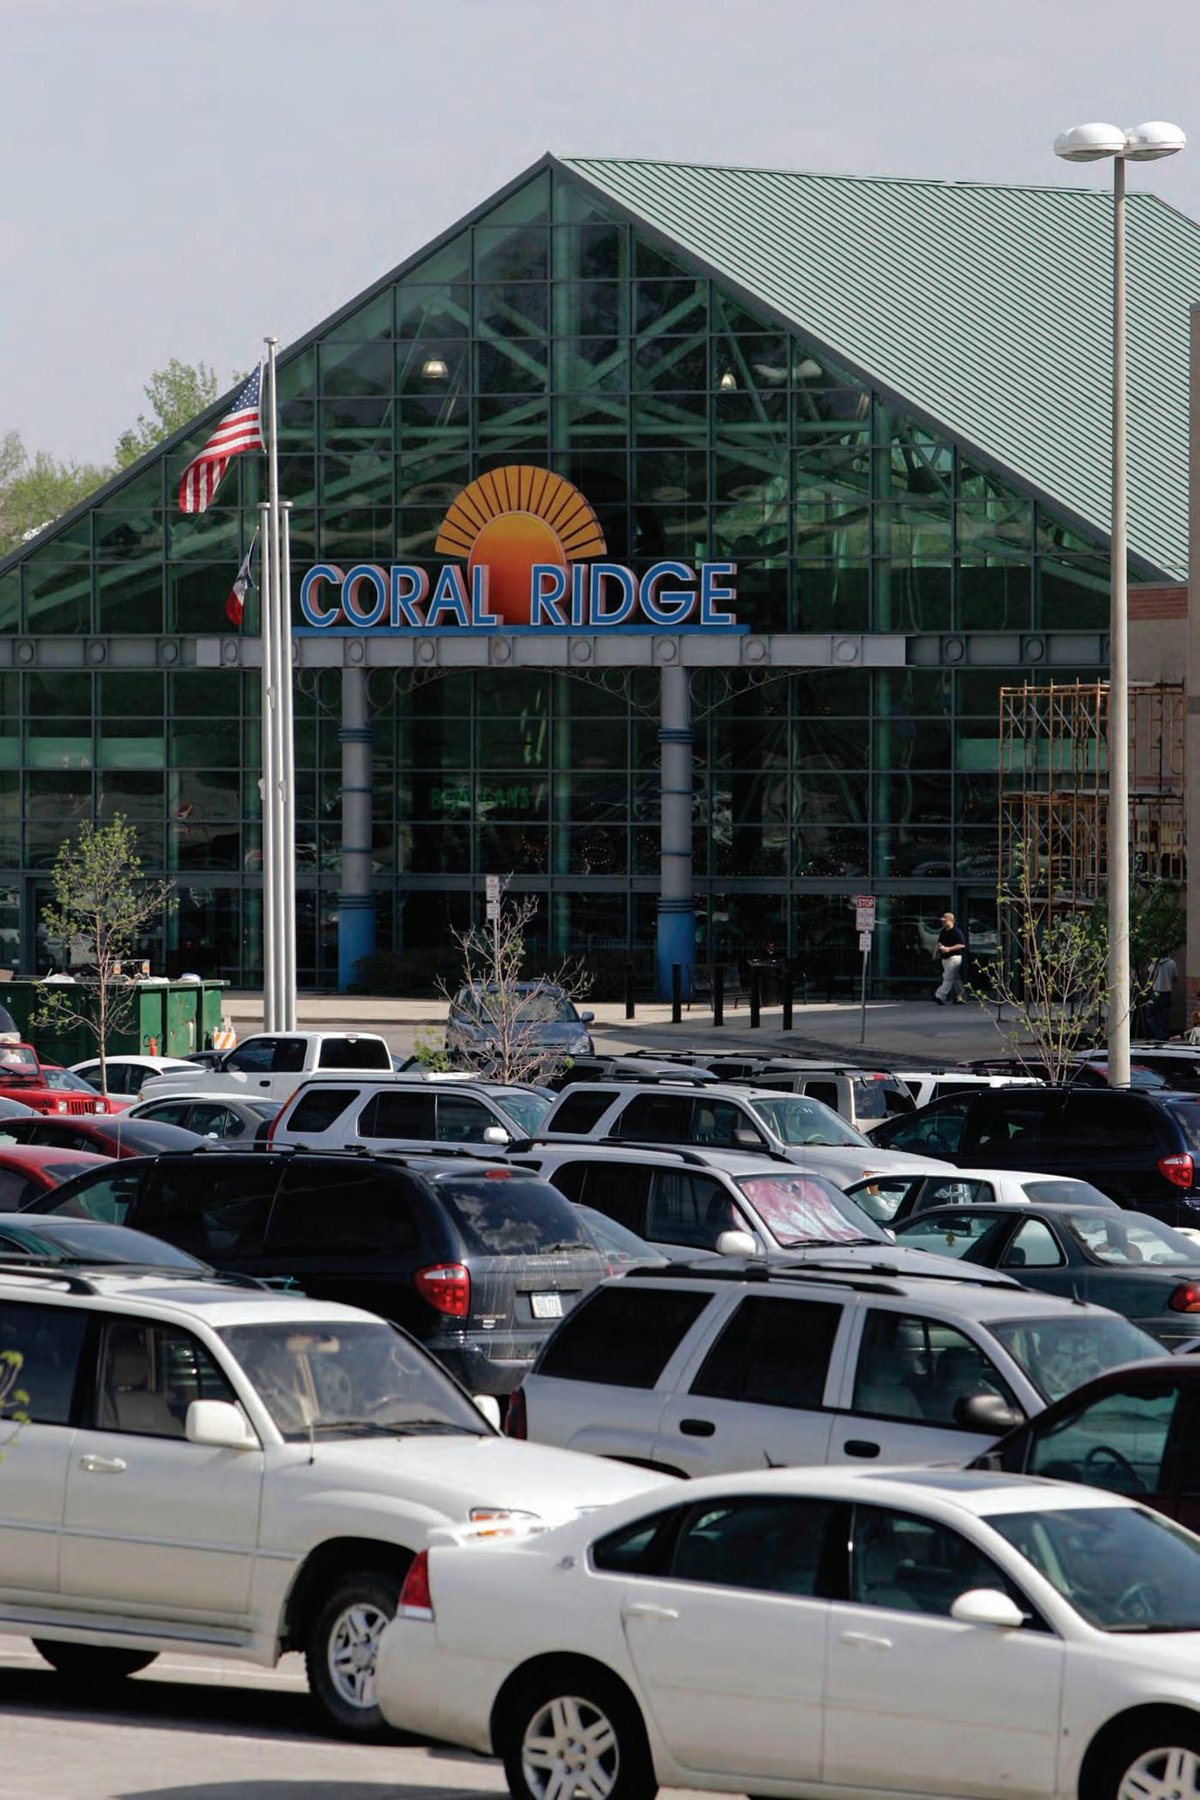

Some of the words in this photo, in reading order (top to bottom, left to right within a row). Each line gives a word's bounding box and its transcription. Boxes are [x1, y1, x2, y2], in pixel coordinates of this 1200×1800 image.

[300, 563, 501, 627] CORAL
[530, 561, 737, 626] RIDGE
[857, 898, 874, 908] STOP
